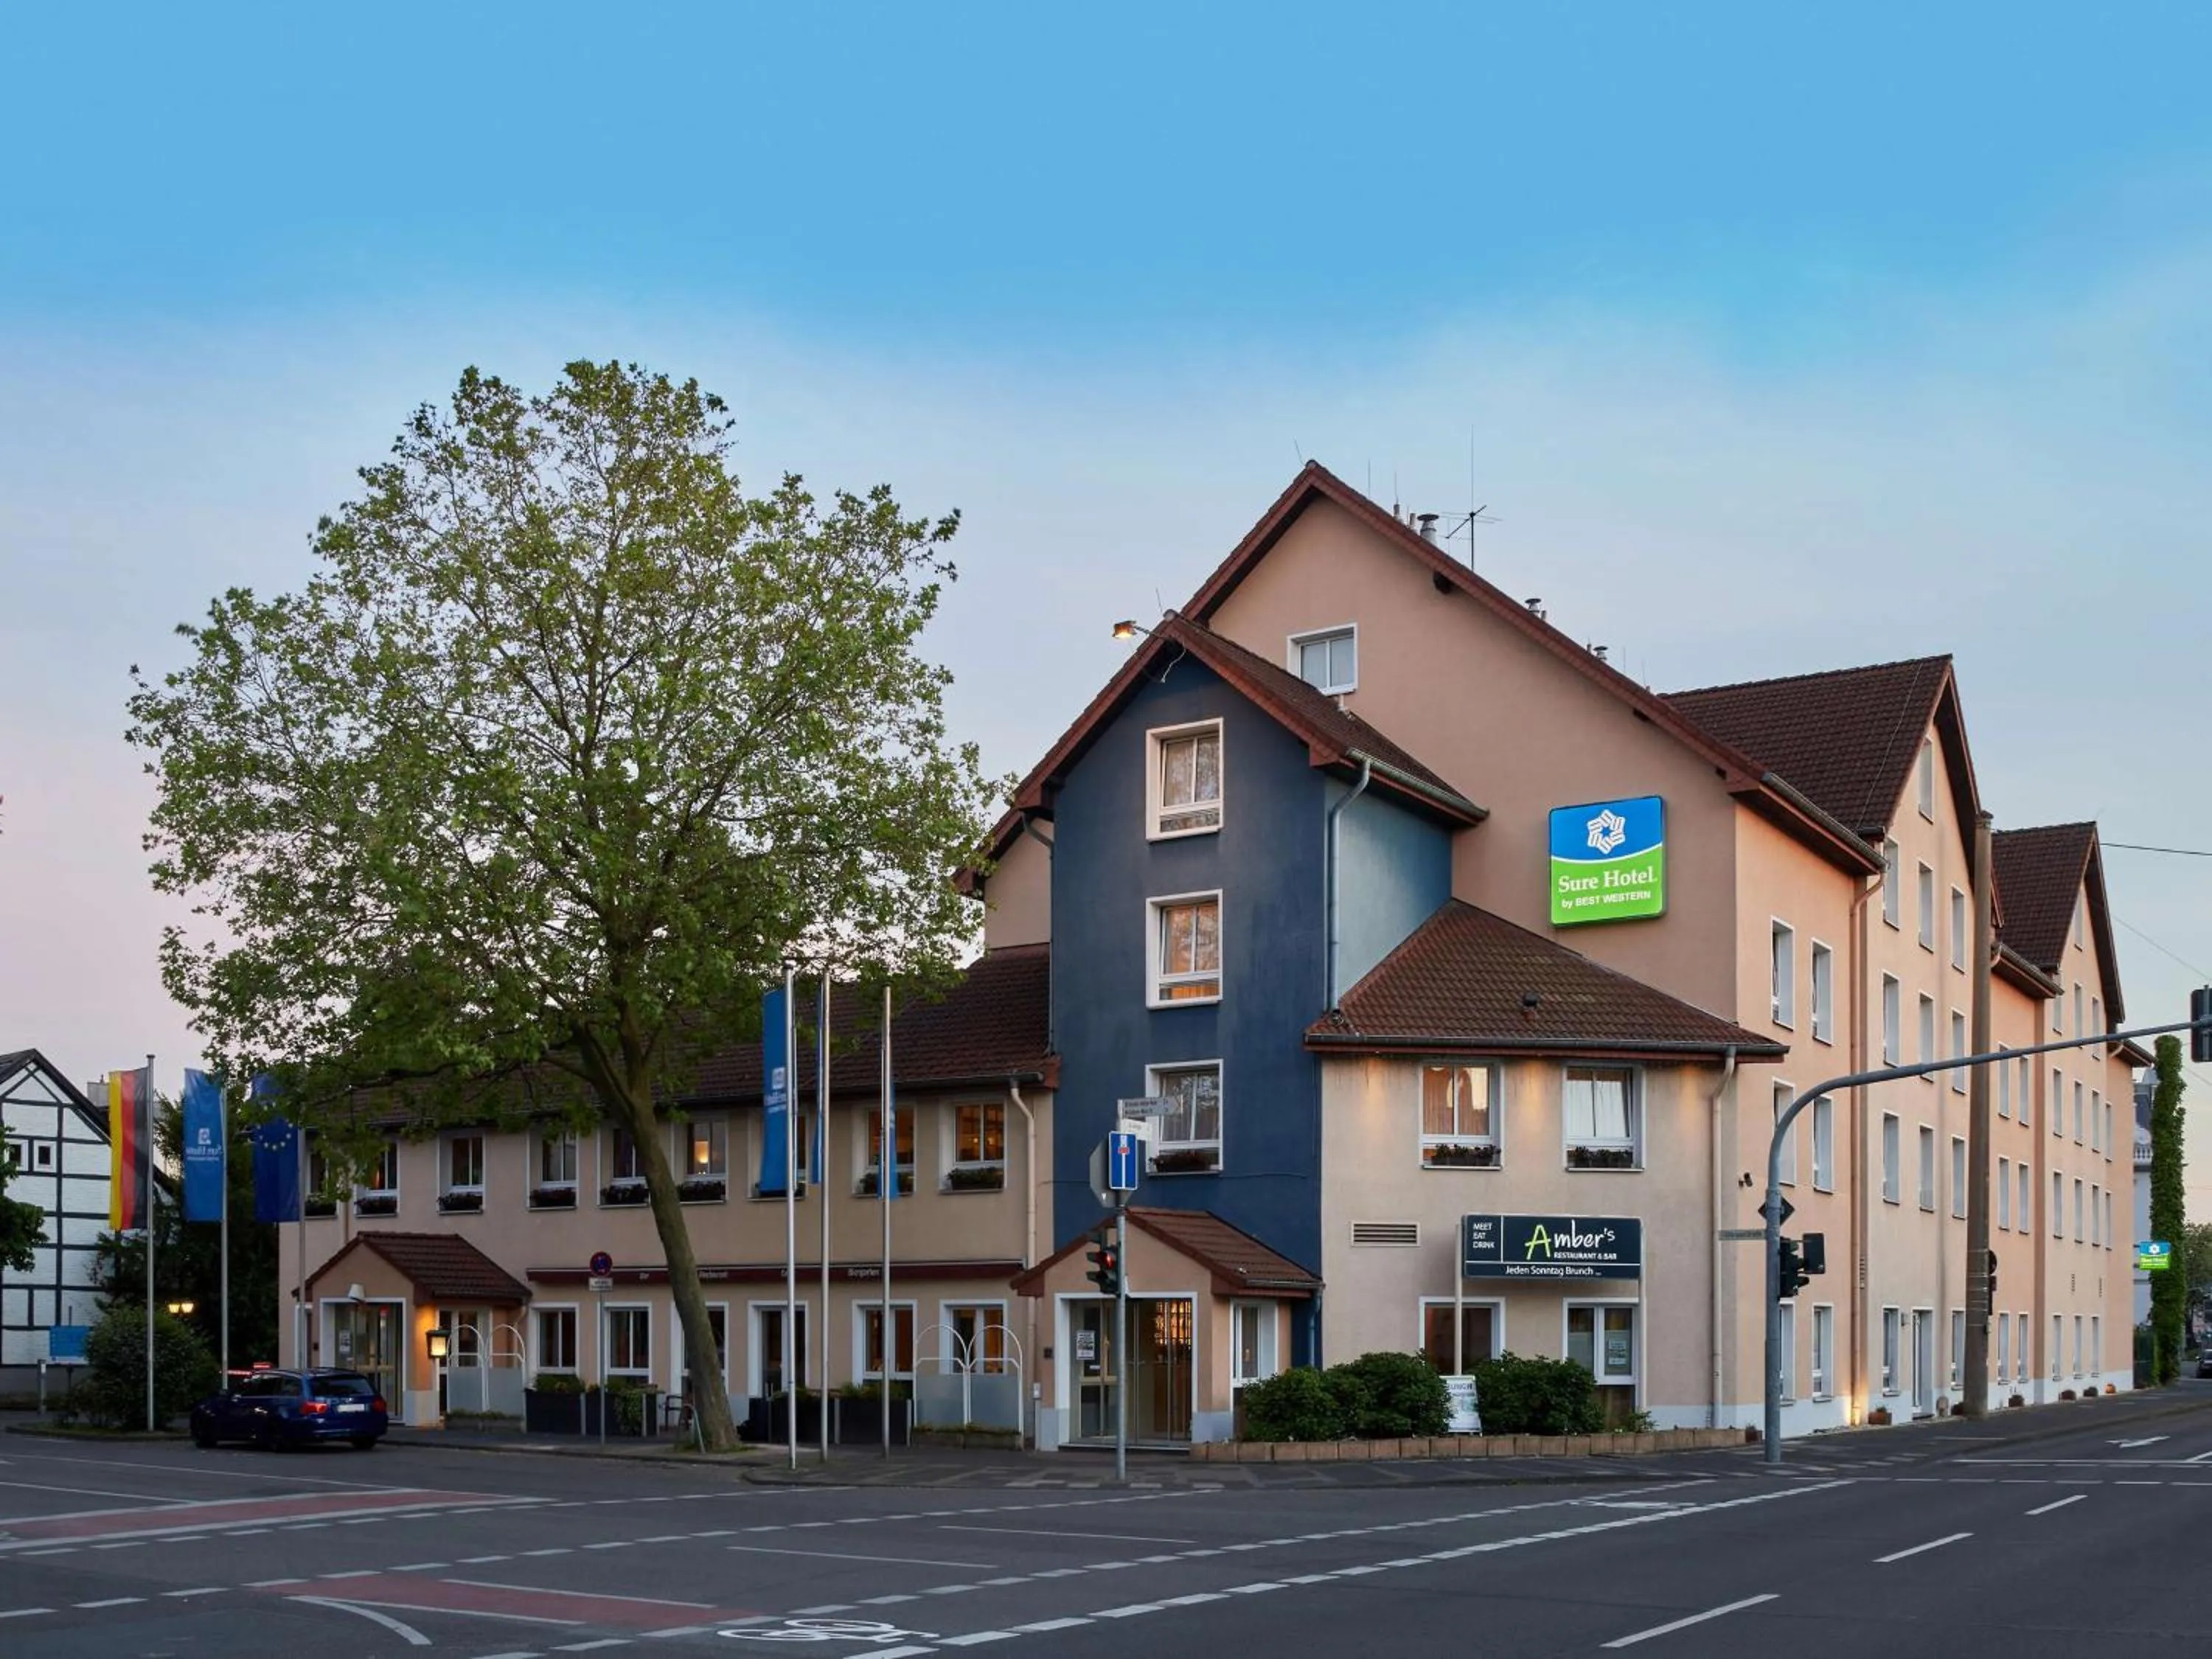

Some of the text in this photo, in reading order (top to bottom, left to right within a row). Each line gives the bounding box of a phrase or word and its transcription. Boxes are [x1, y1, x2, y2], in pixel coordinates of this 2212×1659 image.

[1558, 866, 1656, 893] Sure Hotel
[1561, 890, 1652, 909] by BEST WESTERN
[1473, 1222, 1492, 1231] MEET
[1472, 1241, 1495, 1249] DRINK
[1524, 1219, 1615, 1261] Amber's
[1505, 1265, 1529, 1275] Jeden
[1531, 1265, 1564, 1276] Sonntag
[1565, 1267, 1593, 1276] Brunch
